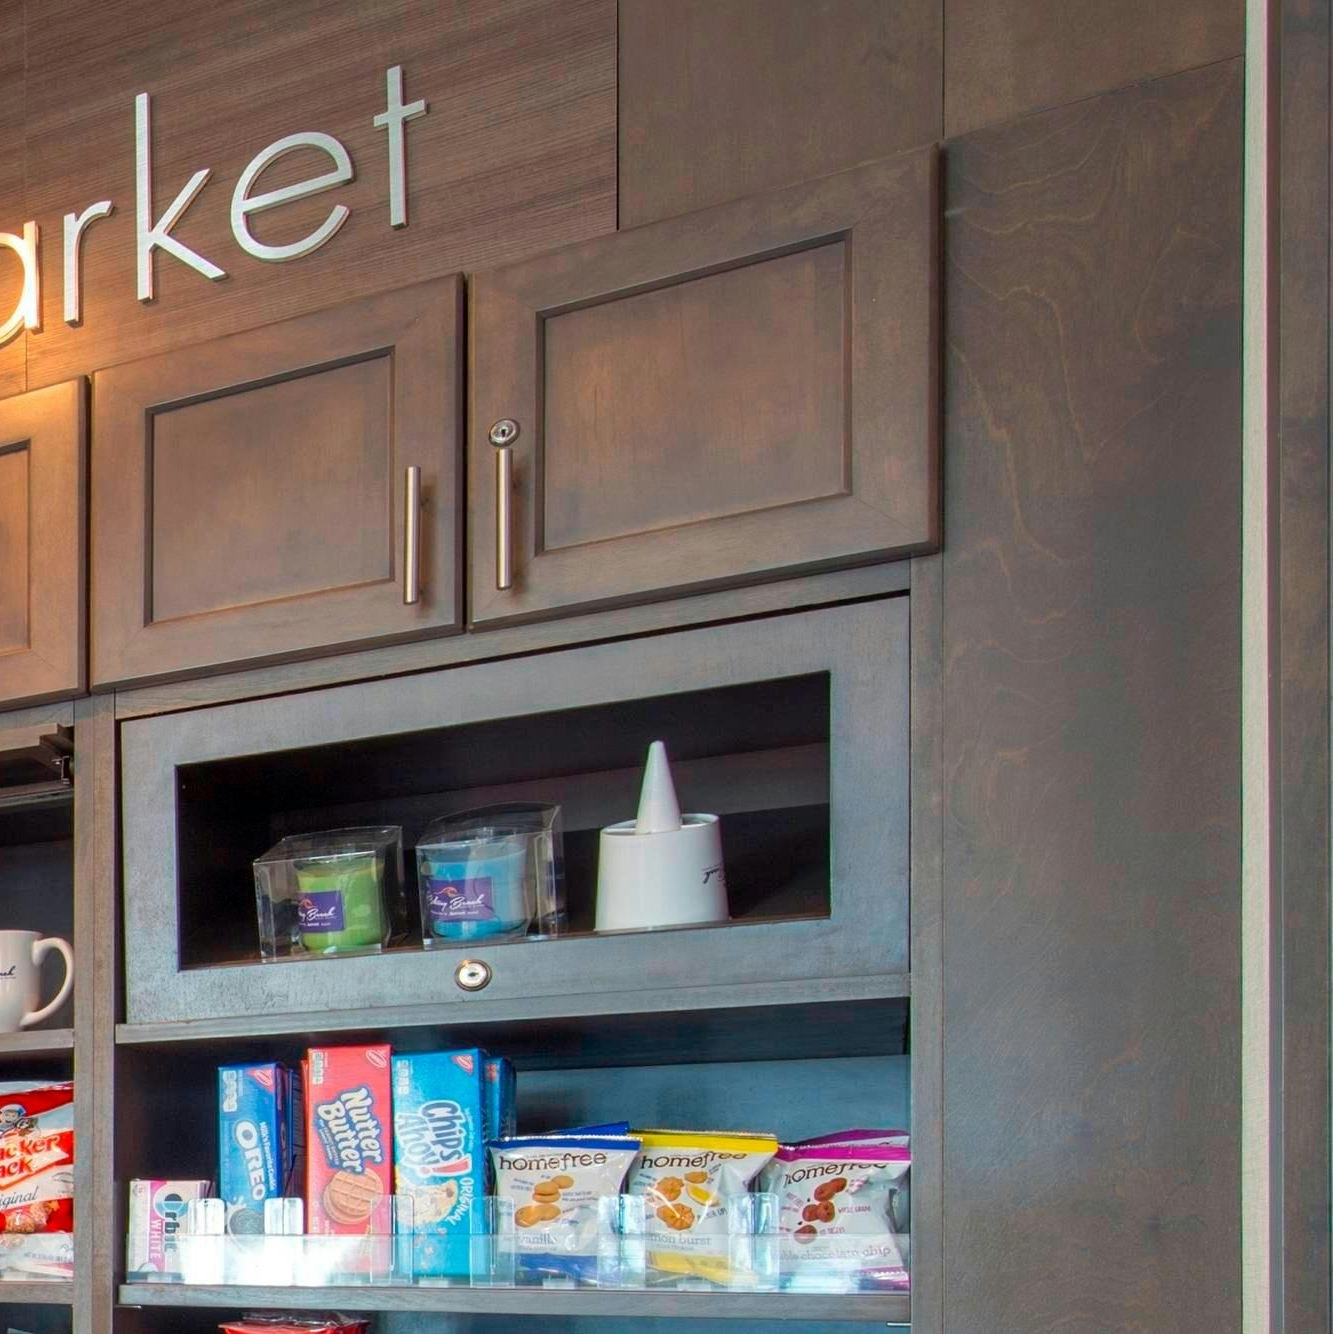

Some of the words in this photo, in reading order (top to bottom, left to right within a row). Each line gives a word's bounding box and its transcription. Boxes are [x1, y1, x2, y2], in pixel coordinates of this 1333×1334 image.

[317, 1101, 364, 1174] Butter
[339, 1087, 383, 1164] Nutter
[420, 1101, 465, 1164] Chips
[234, 1119, 267, 1201] OREO
[499, 1151, 608, 1172] homefree
[445, 1177, 474, 1226] ORIGINAL
